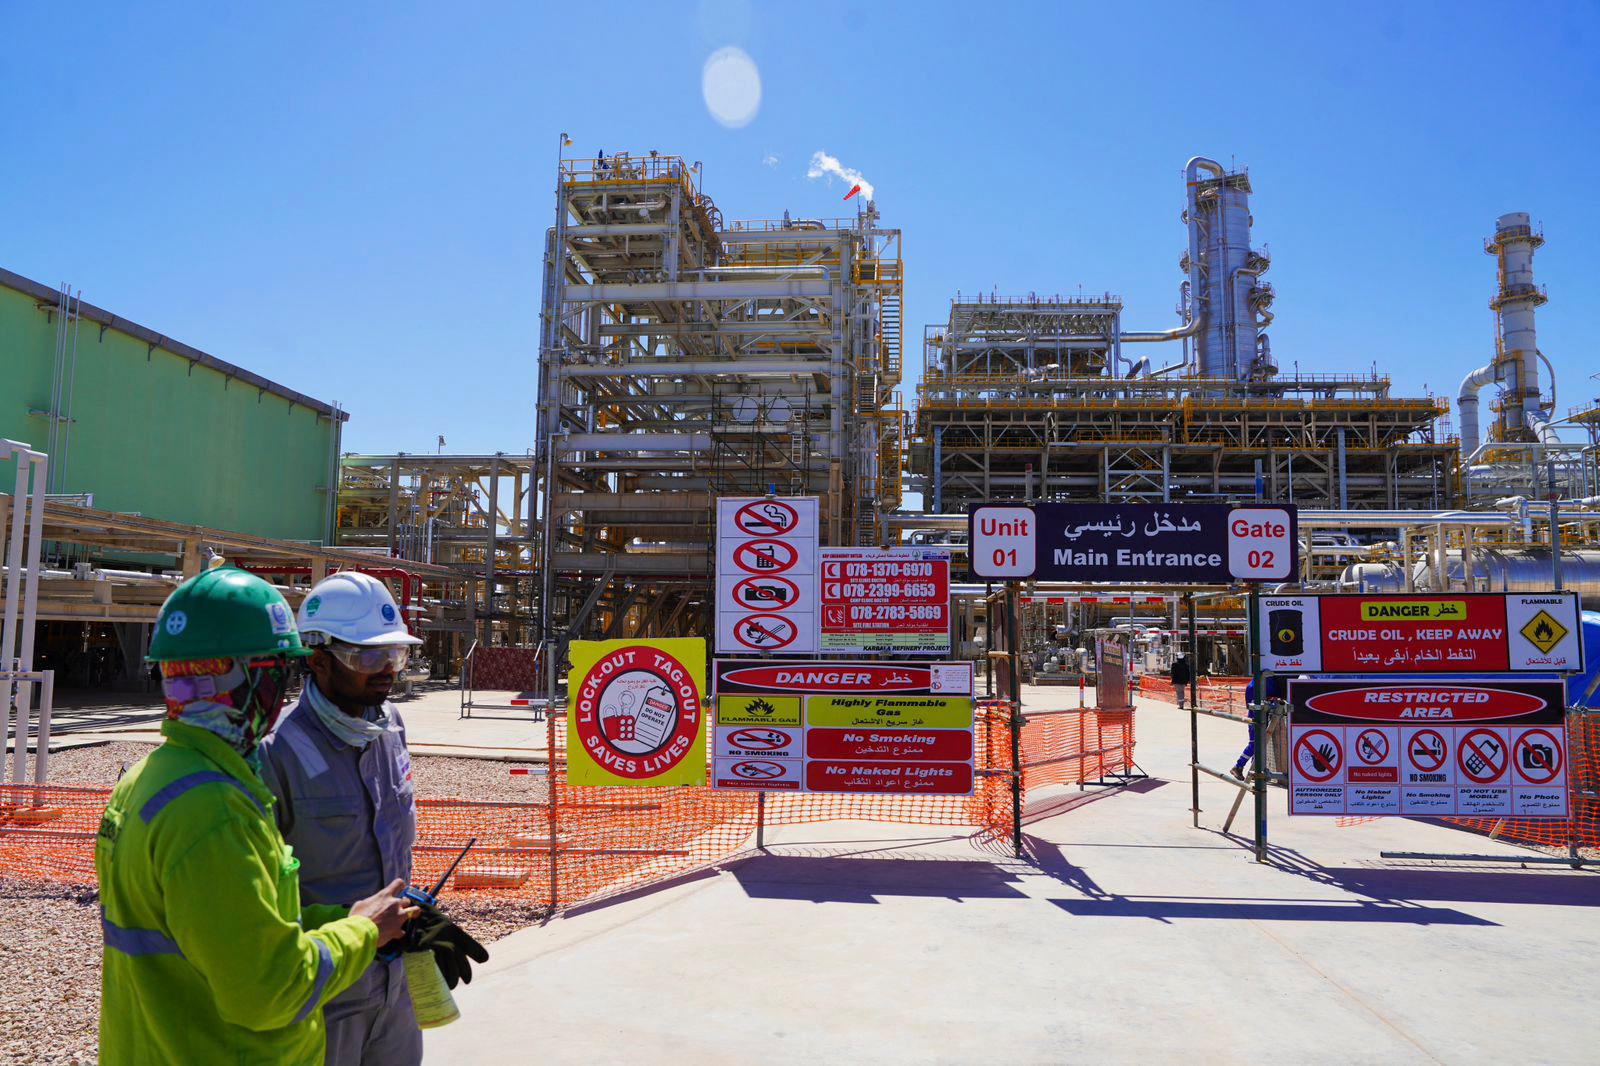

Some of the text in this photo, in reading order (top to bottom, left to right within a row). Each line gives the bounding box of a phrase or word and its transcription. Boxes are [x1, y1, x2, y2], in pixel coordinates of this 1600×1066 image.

[981, 518, 1028, 537] Unit
[1064, 512, 1202, 541] مدخل رئيسي
[1231, 519, 1286, 538] Gate
[992, 548, 1017, 567] 01
[1054, 549, 1222, 566] Main Entrance
[1247, 550, 1274, 569] 02
[843, 583, 936, 598] 078-2399-6653
[850, 605, 942, 620] 078-2783-5869
[1369, 605, 1430, 617] DANGER
[1434, 603, 1458, 618] خطر
[1328, 629, 1377, 641] CRUDE
[1380, 629, 1405, 641] OIL
[1416, 628, 1453, 640] KEEP
[1457, 628, 1503, 640] AWAY
[1446, 647, 1477, 662] النفط
[1275, 658, 1302, 669] نفط خام
[775, 673, 871, 685] DANGER
[879, 674, 913, 688] خطر
[580, 651, 696, 724] LOCK-OUT TAG-OUT
[831, 699, 947, 708] Highly Flammable
[1364, 692, 1490, 704] RESTRICTED
[641, 712, 666, 726] OPERATE
[876, 709, 902, 717] Gas
[1399, 707, 1453, 718] AREA
[886, 718, 908, 727] سريع
[842, 734, 936, 745] No Smoking
[586, 735, 689, 773] SAVES LIVES
[855, 746, 923, 756] ممنوع التدخين
[825, 766, 954, 778] No Naked Lights
[1409, 774, 1447, 783] NO SMOKING
[903, 778, 935, 788] ممنوع
